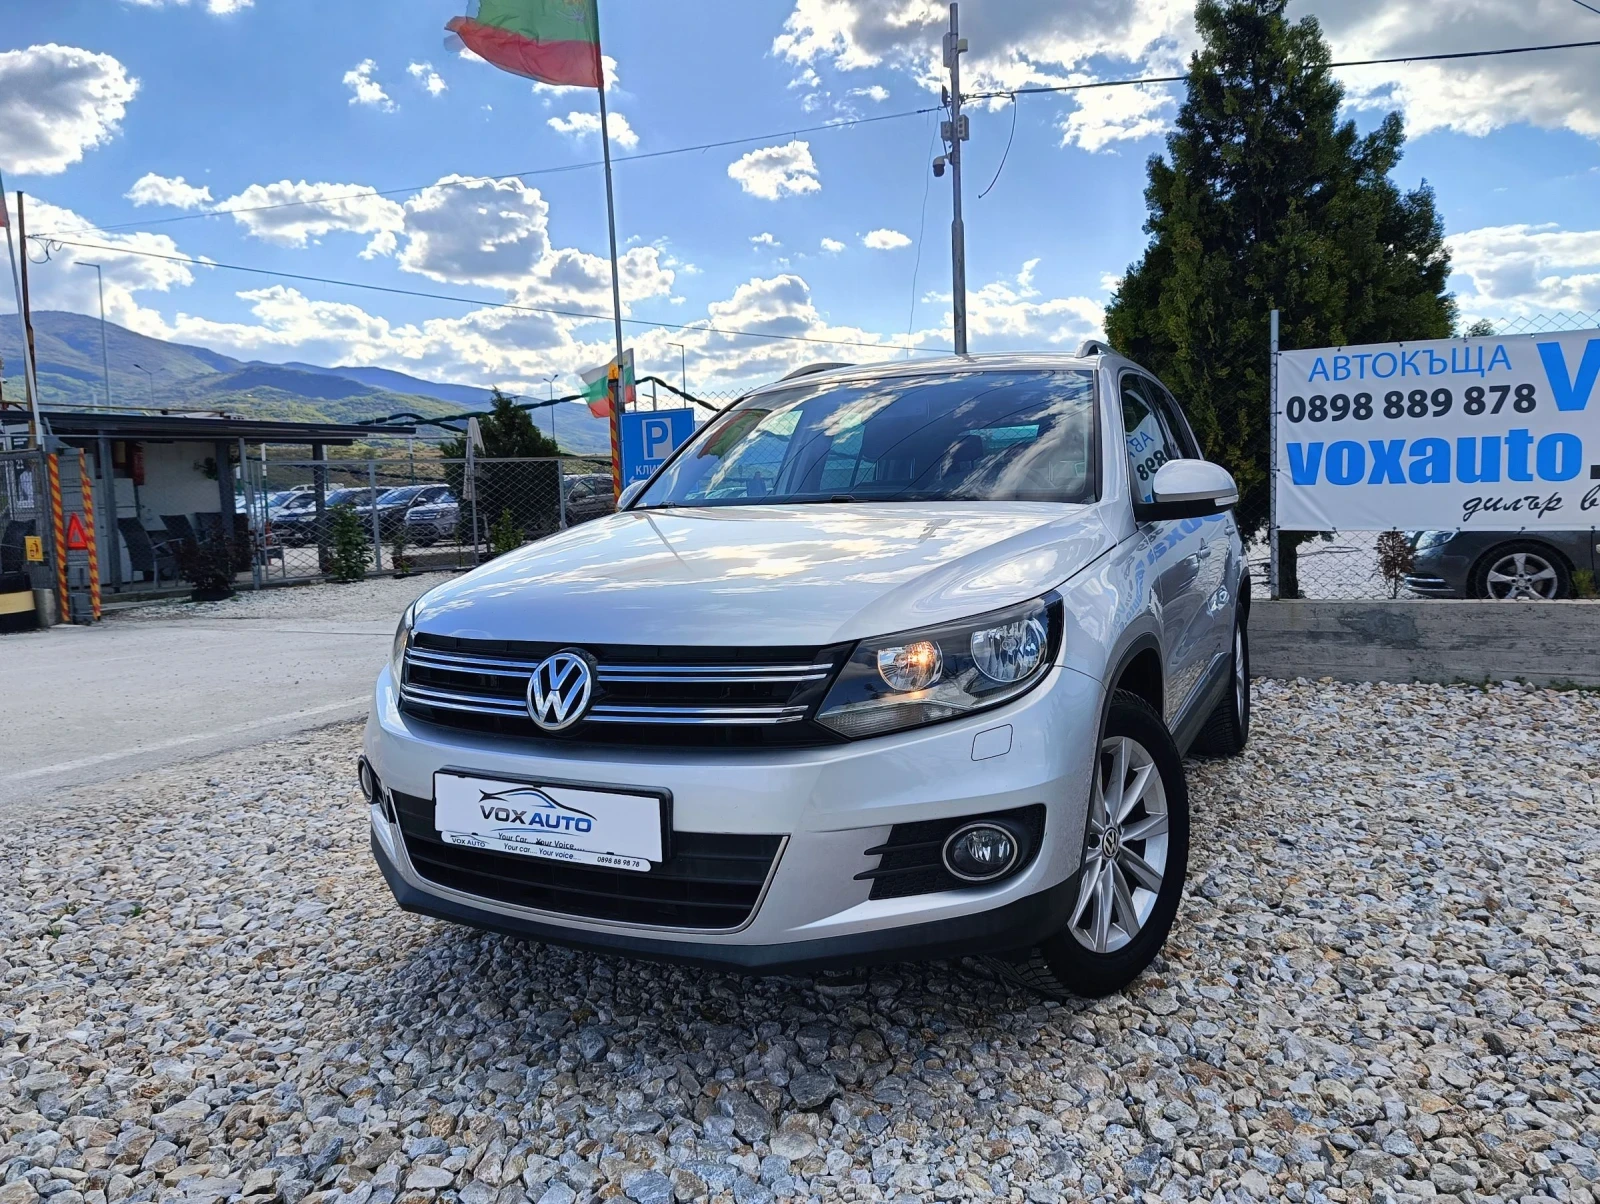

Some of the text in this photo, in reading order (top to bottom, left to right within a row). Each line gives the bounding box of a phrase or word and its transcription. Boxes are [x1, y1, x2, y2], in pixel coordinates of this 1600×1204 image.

[1308, 344, 1512, 382] АВТОКЪЩА
[1286, 383, 1537, 423] 0898 889 878
[635, 464, 661, 476] КЛИ
[1462, 491, 1564, 522] дилър
[451, 837, 486, 848] VOX AUTO
[498, 832, 513, 841] Your
[504, 843, 518, 851] Your
[539, 848, 554, 857] Your
[597, 856, 612, 864] 0898
[632, 860, 640, 868] 78
